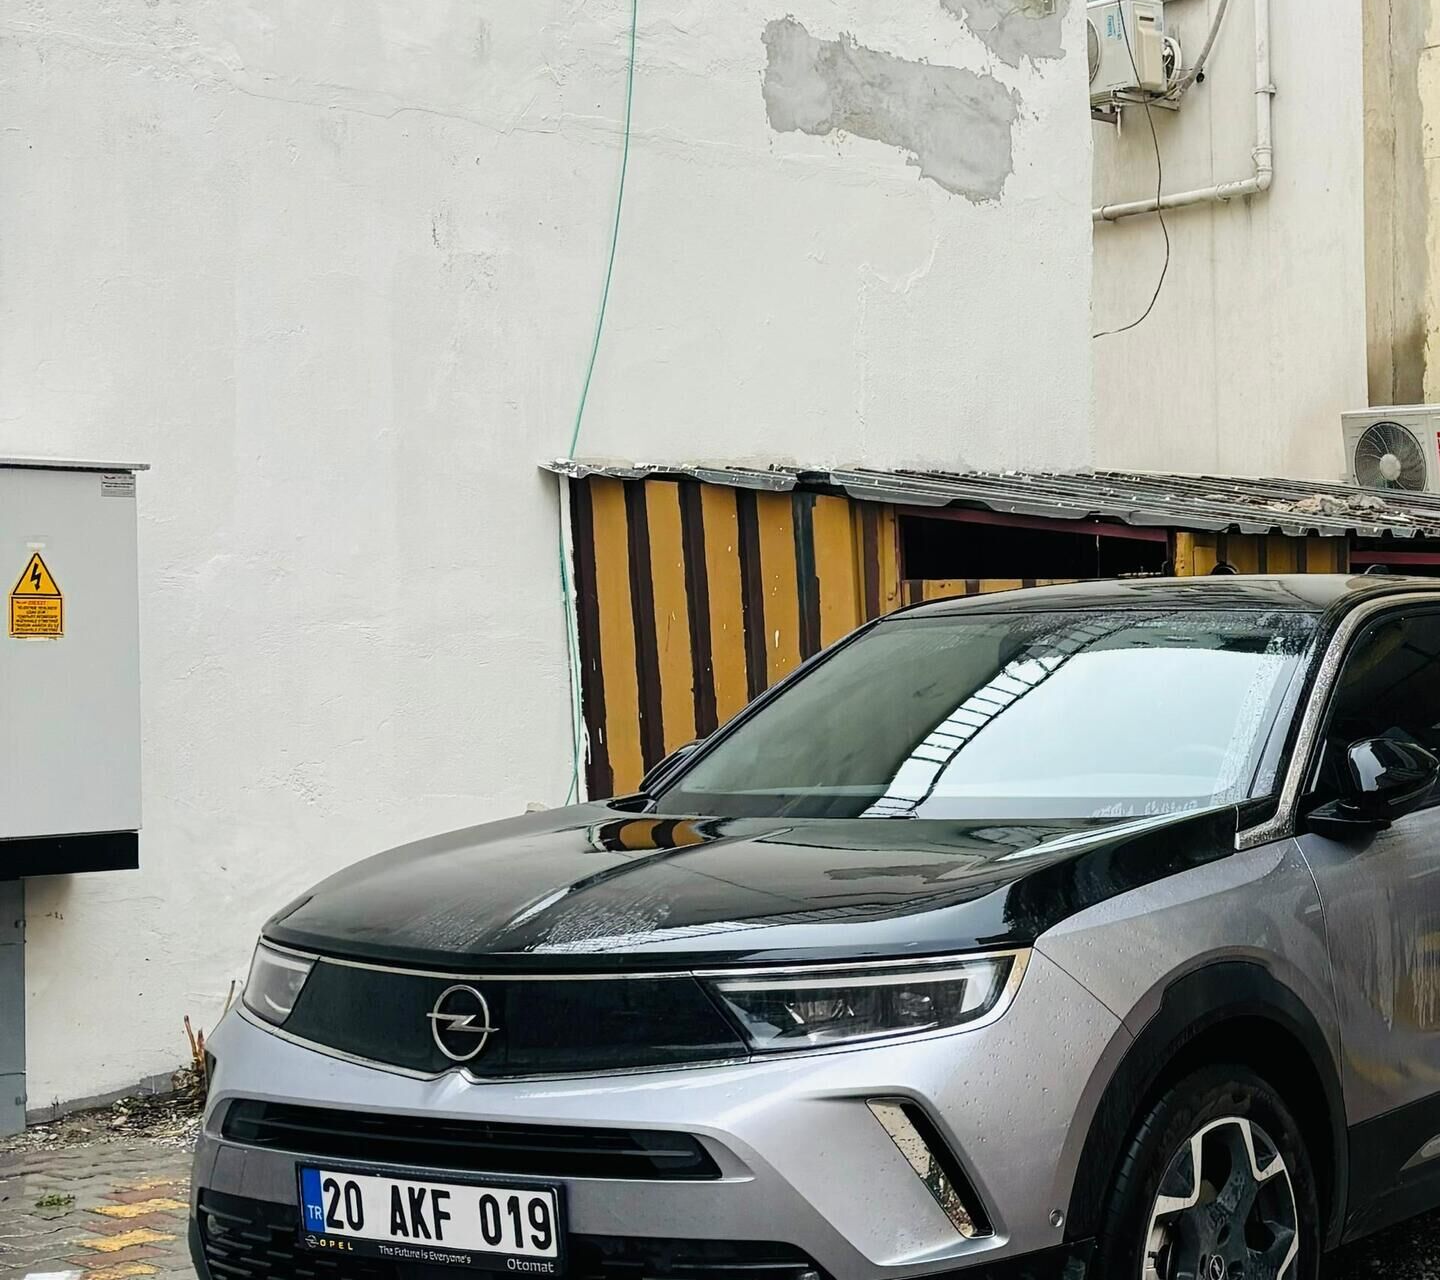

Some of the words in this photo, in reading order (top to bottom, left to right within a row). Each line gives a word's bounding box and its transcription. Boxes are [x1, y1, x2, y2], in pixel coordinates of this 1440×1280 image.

[307, 1204, 323, 1221] TR
[323, 1177, 364, 1232] 20
[390, 1184, 452, 1241] AKF
[479, 1193, 552, 1250] 019
[320, 1239, 354, 1251] OPEL
[378, 1245, 394, 1256] The
[394, 1247, 421, 1259] Future
[507, 1258, 555, 1273] Otomat
